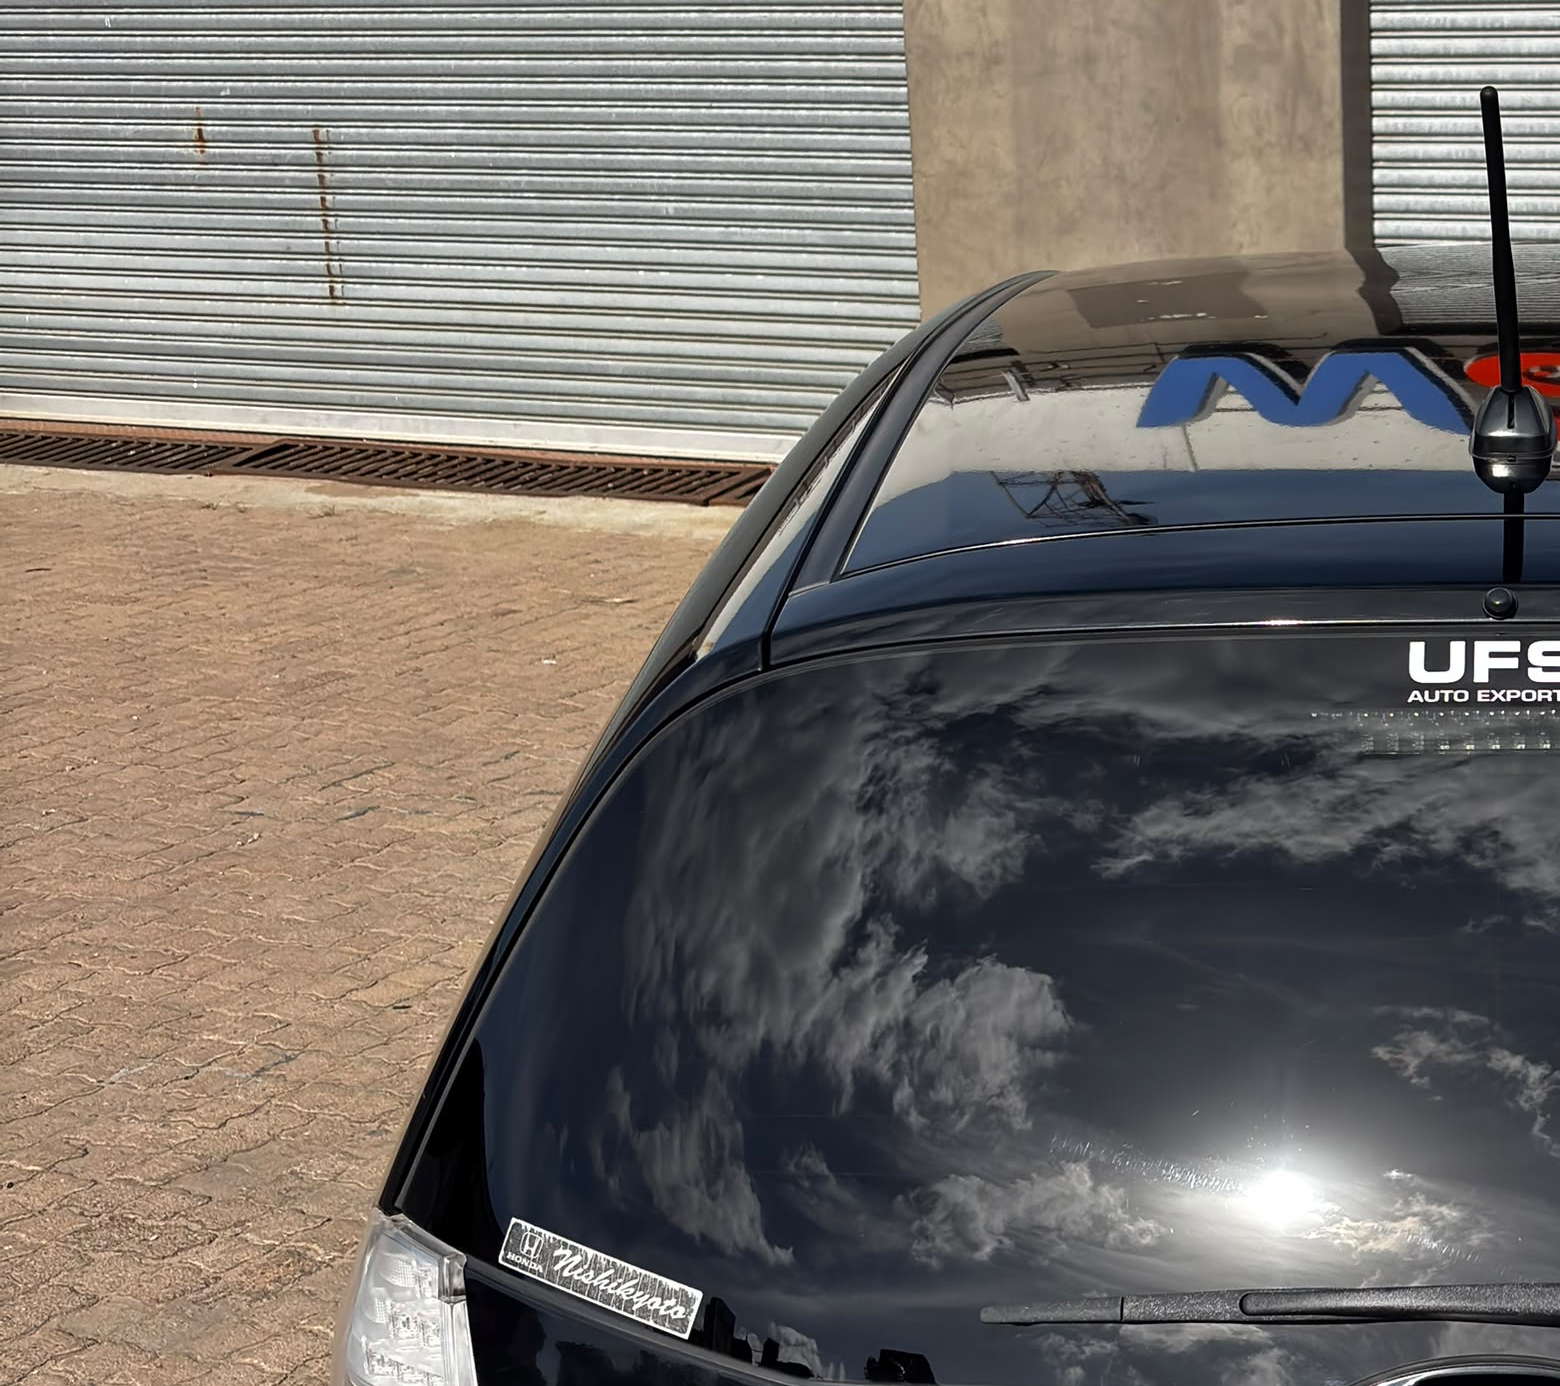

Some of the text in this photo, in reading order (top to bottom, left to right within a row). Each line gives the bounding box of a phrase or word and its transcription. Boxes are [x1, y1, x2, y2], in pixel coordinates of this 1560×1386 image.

[1406, 689, 1470, 704] AUTO
[506, 1251, 545, 1273] HONDA
[552, 1246, 688, 1320] Nishikyoto
